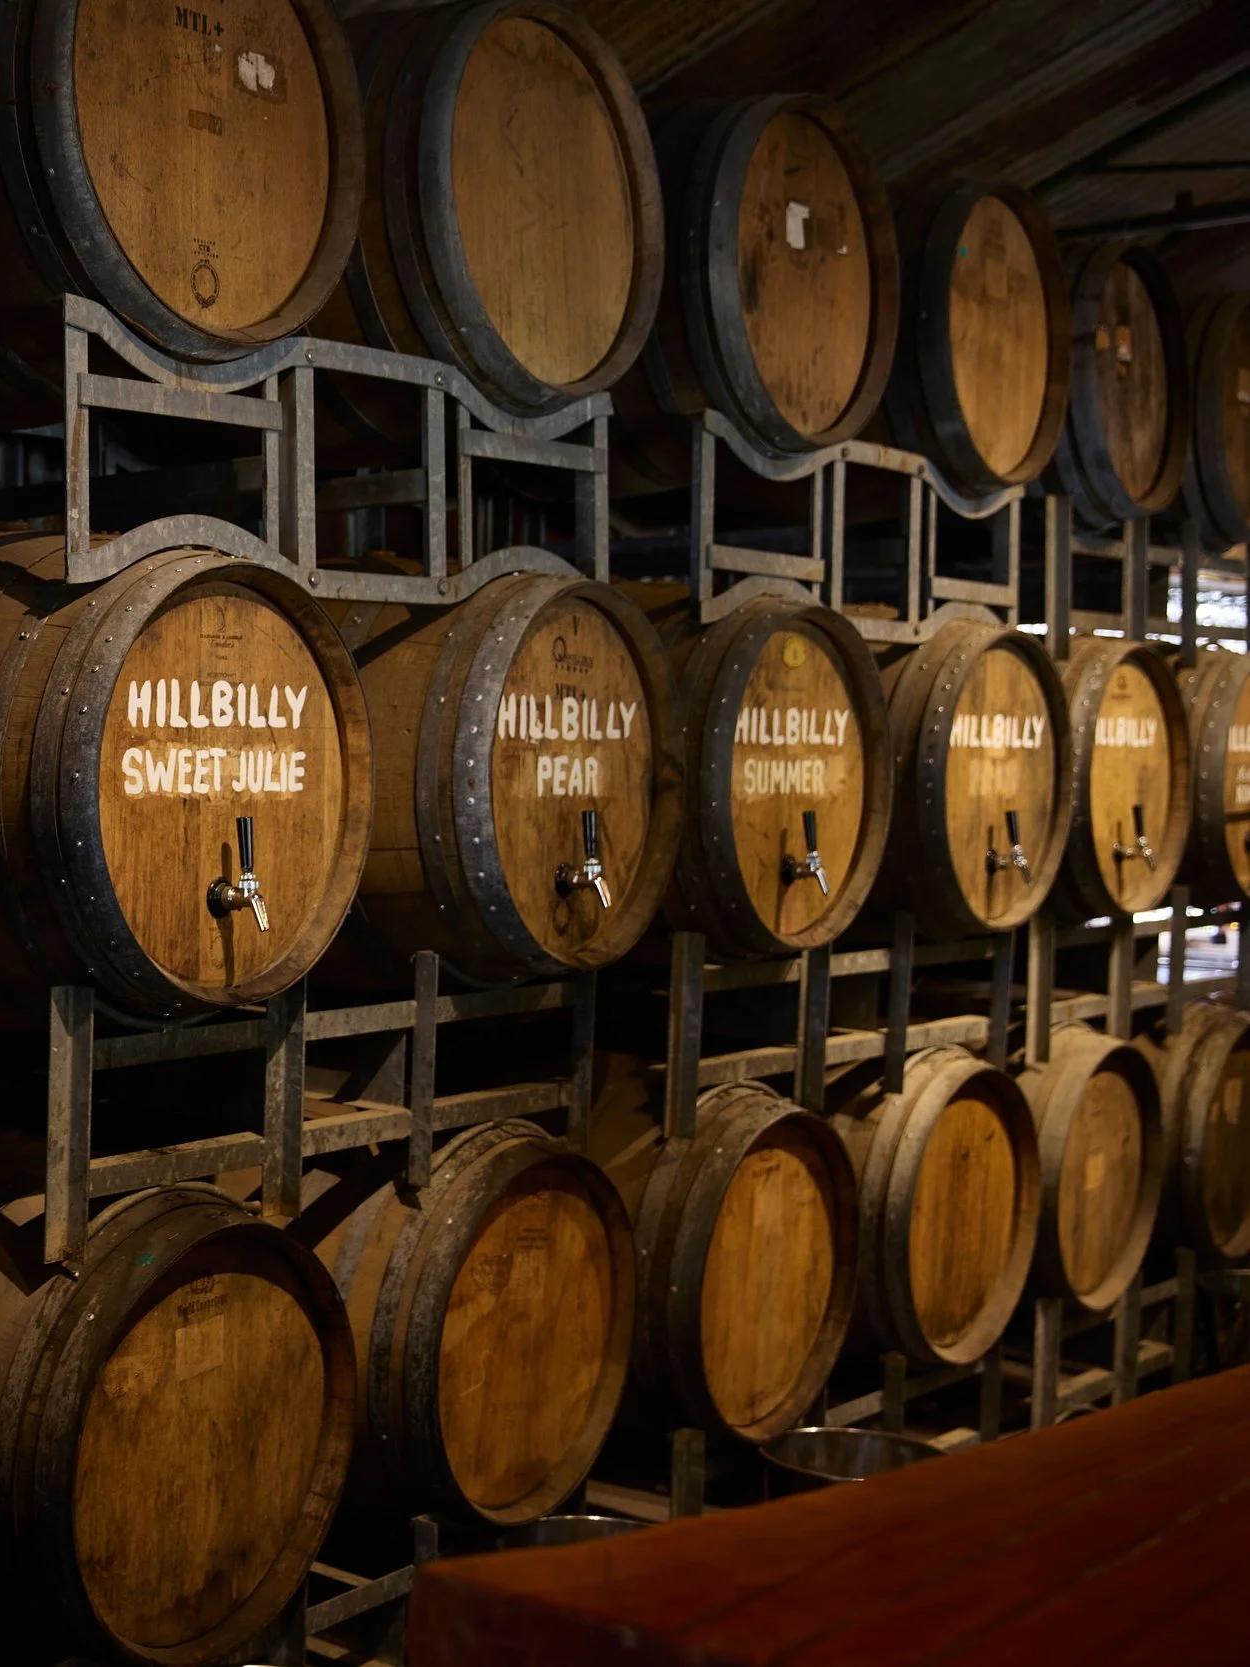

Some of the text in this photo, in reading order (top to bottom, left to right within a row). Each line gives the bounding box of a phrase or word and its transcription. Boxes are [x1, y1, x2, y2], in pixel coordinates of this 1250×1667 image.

[127, 678, 308, 729] HILLBILLY
[498, 692, 638, 741] HILLBILLY
[734, 707, 850, 747] HILLBILLY
[949, 713, 1046, 750] HILLBILLY
[121, 747, 307, 795] SWEET JULIE
[536, 755, 600, 797] PEAR
[744, 758, 826, 796] SUMMER
